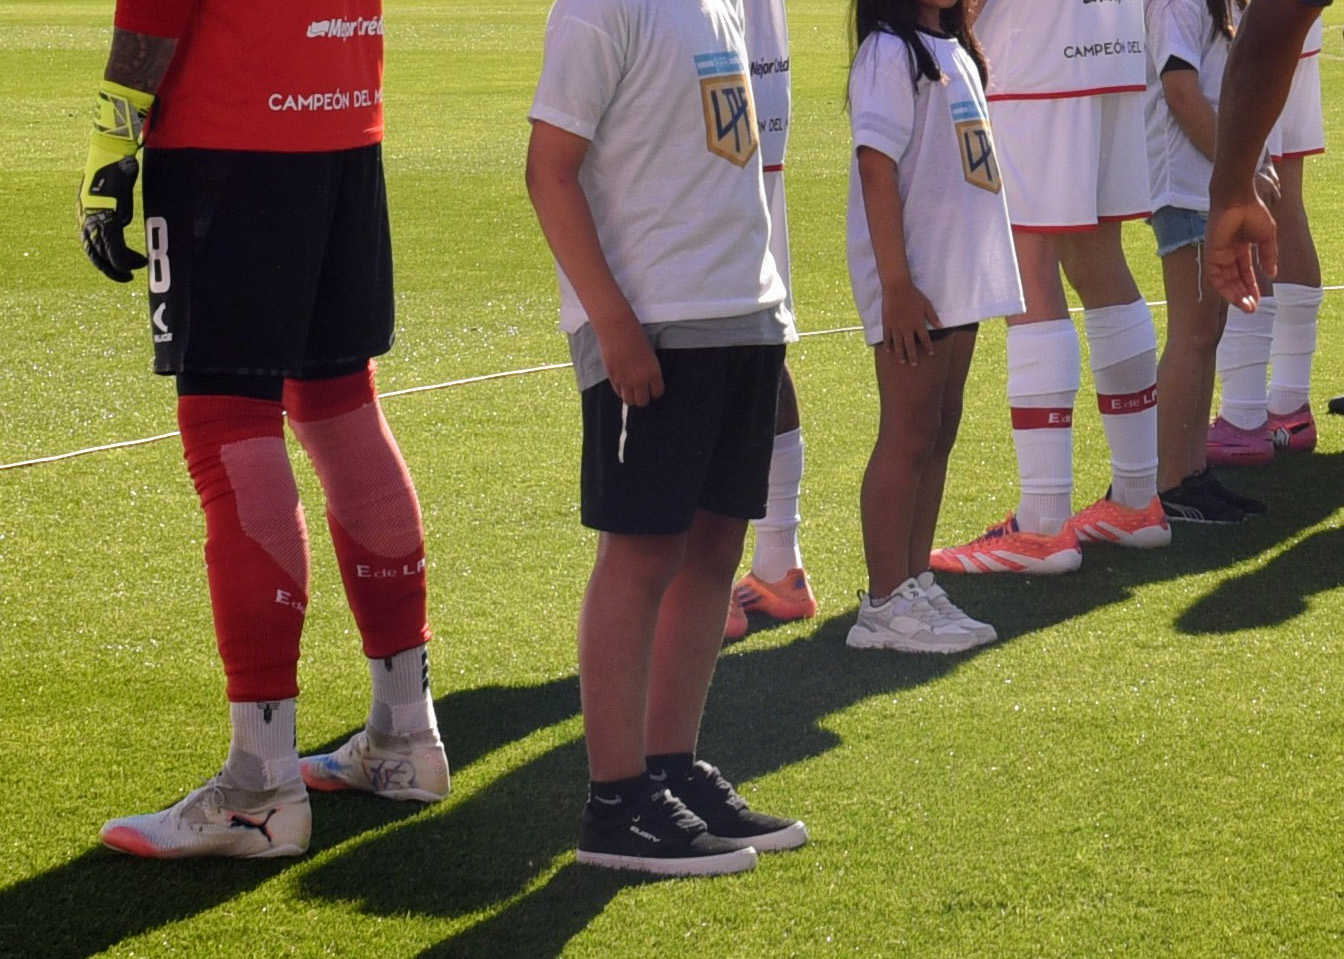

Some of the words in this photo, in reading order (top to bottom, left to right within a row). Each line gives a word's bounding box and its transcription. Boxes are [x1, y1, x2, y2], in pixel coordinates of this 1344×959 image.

[269, 89, 349, 111] CAMPEÓN
[354, 91, 371, 107] DEL
[356, 565, 371, 578] E
[275, 589, 292, 605] E
